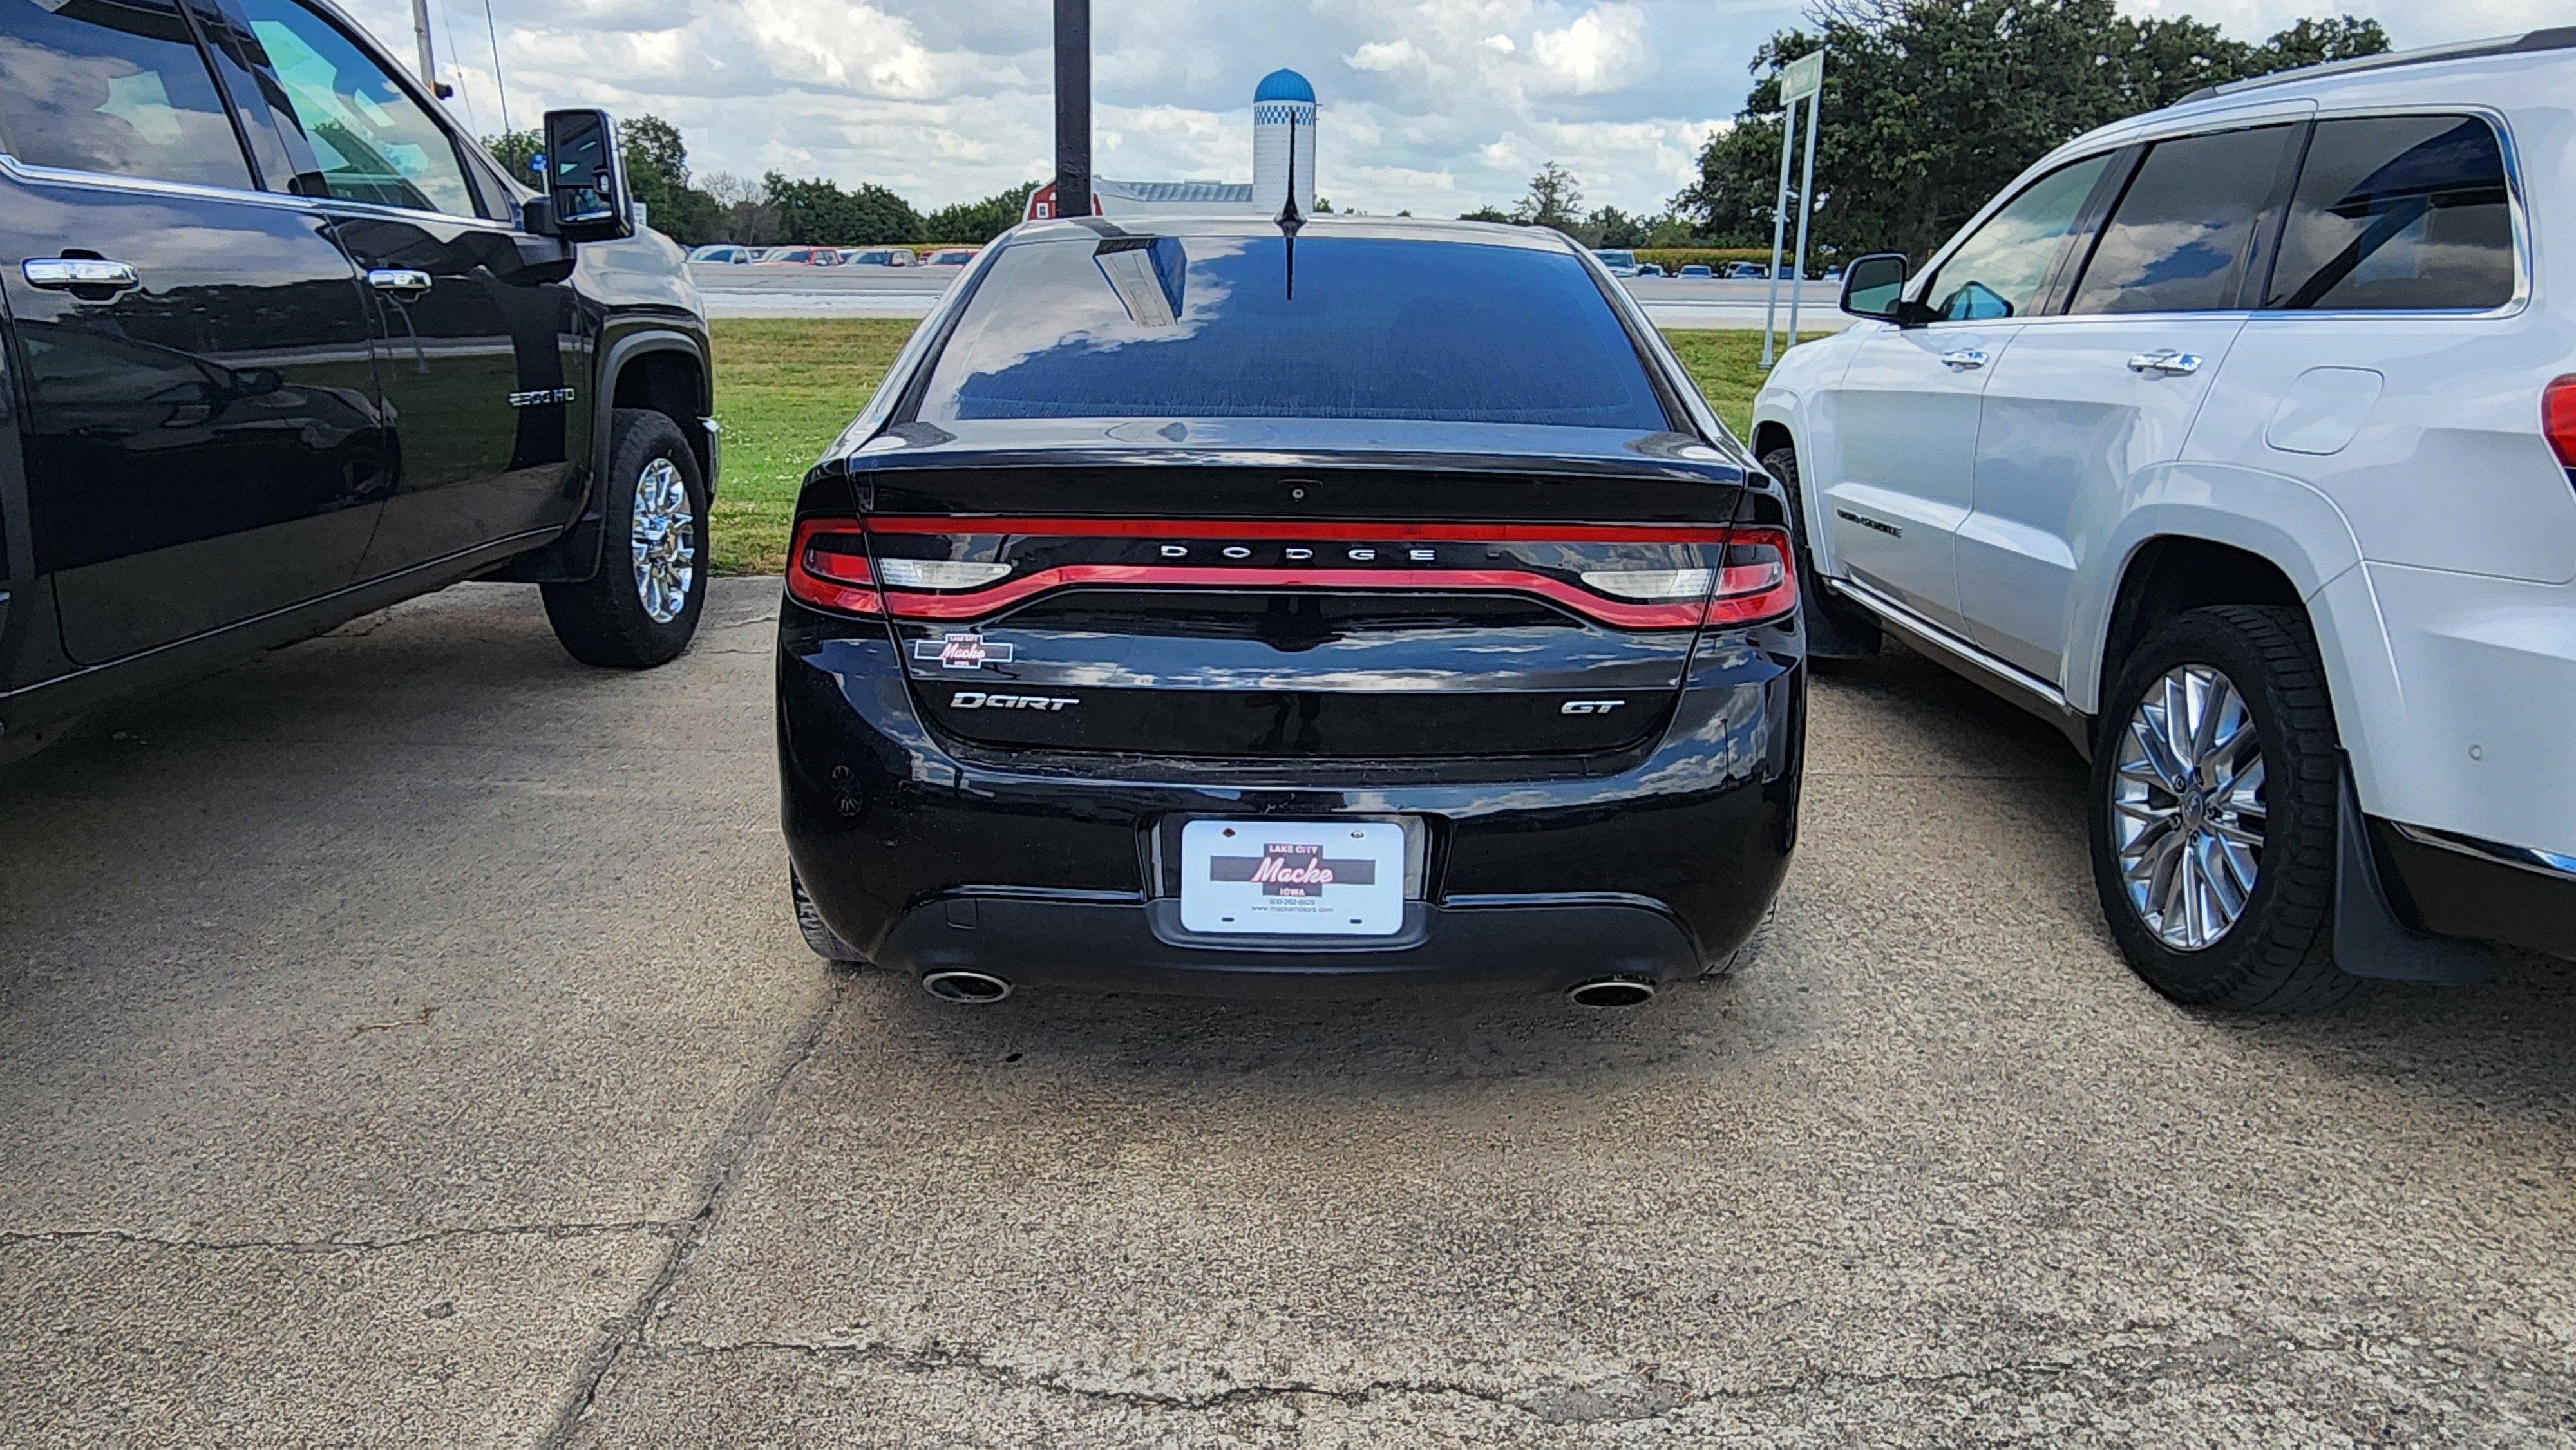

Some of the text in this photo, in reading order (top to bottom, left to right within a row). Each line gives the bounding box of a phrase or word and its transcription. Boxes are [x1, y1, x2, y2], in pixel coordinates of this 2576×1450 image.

[553, 388, 574, 402] HD
[1161, 545, 1435, 560] DODGE
[940, 643, 985, 659] Macke
[1561, 700, 1625, 714] GT
[1269, 845, 1318, 854] LAKE CITY
[1251, 856, 1333, 883] Macke
[1280, 887, 1305, 896] IOWA
